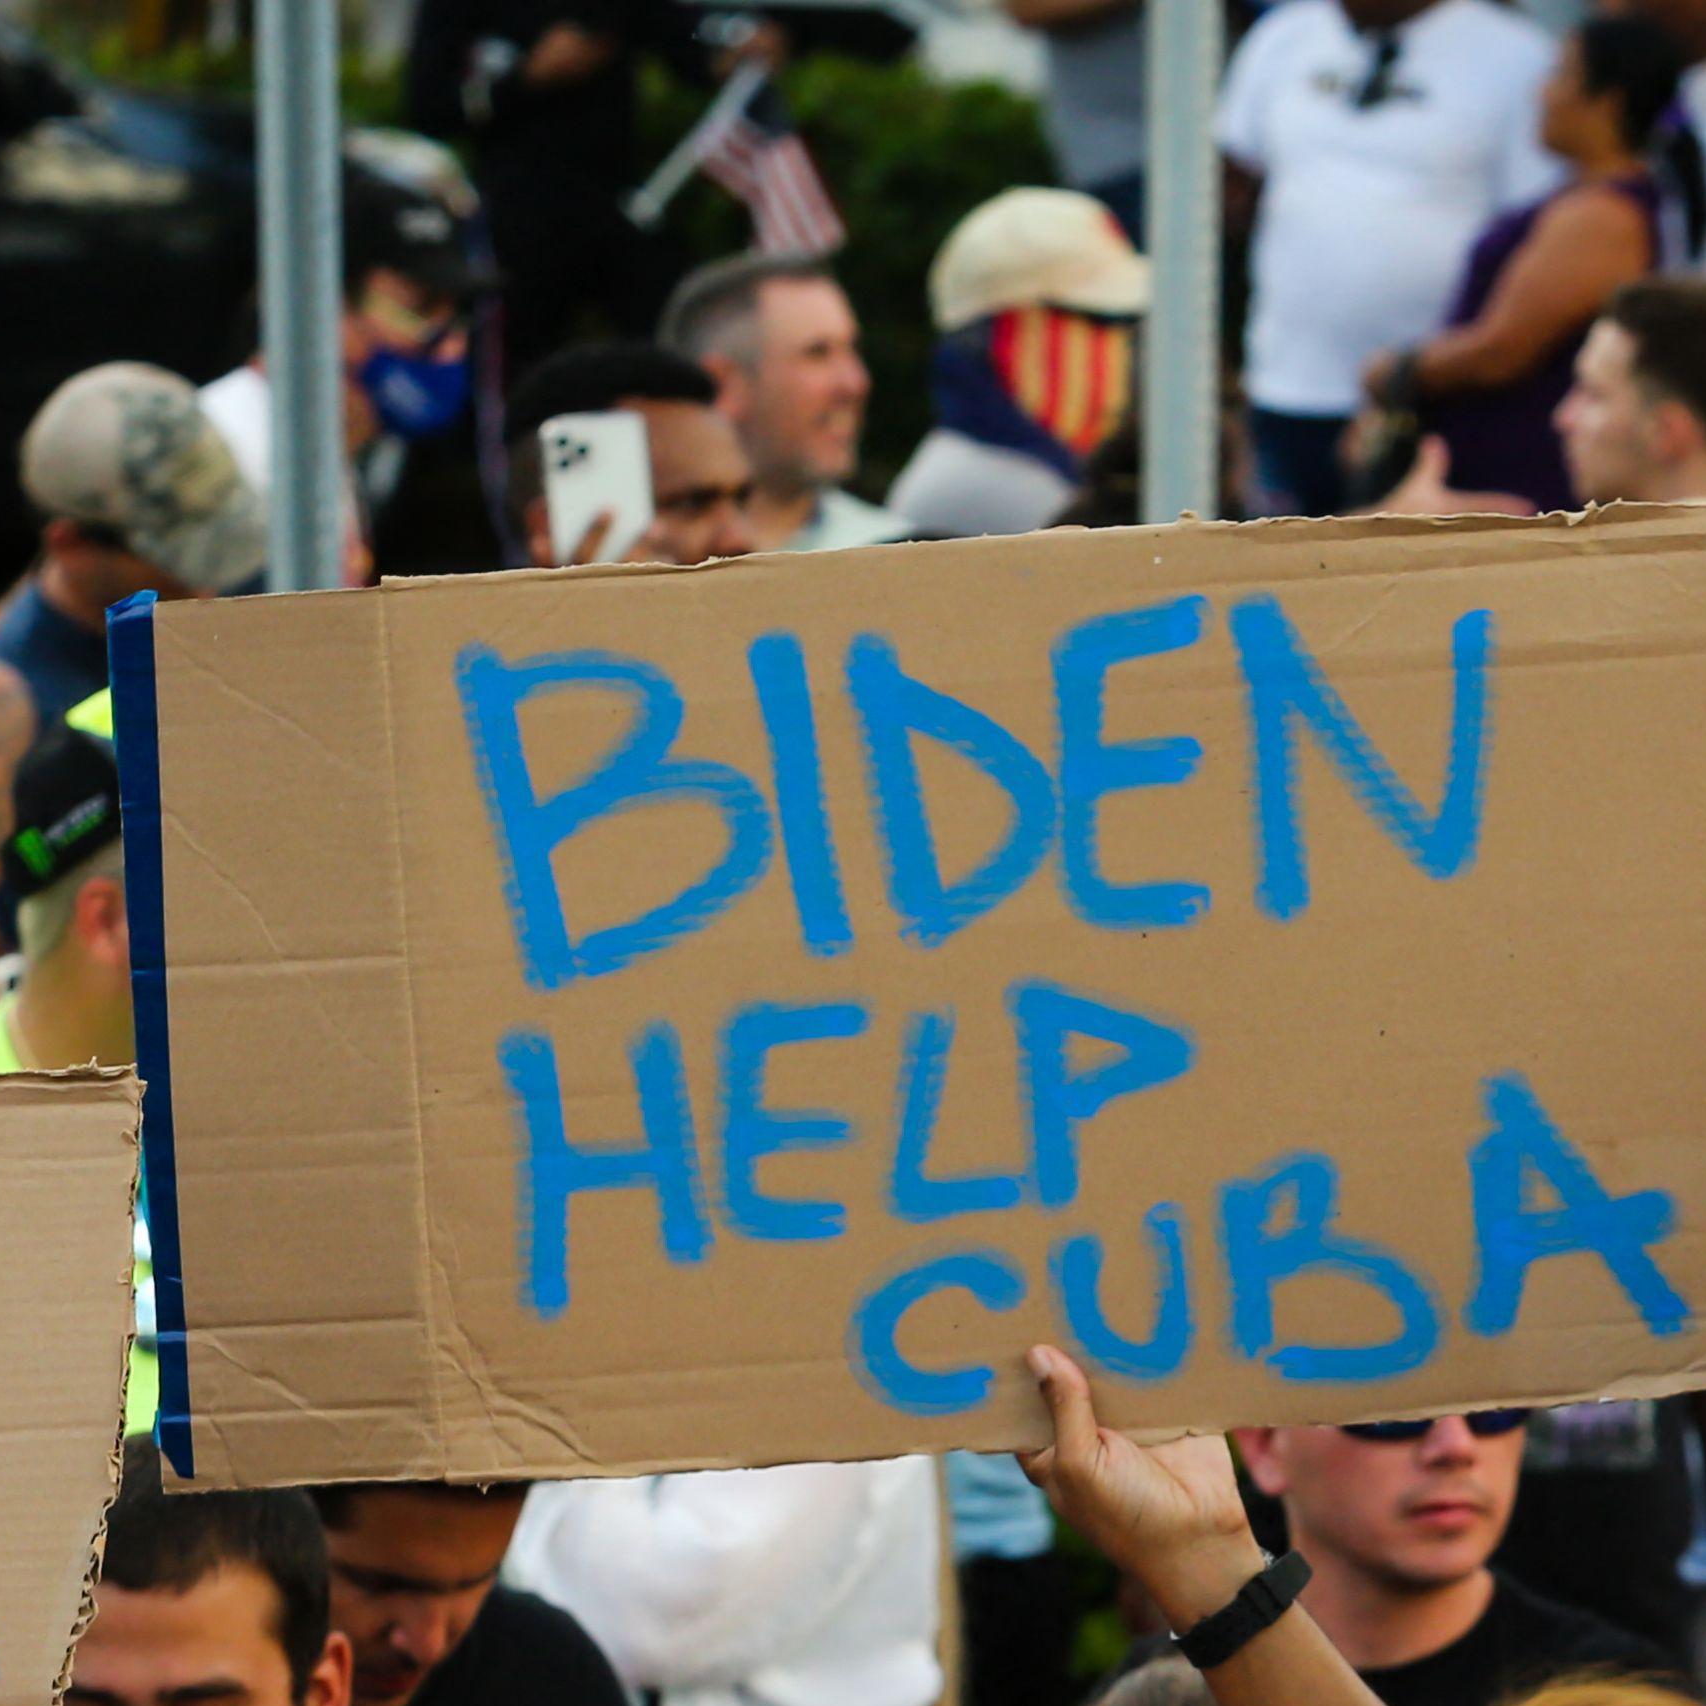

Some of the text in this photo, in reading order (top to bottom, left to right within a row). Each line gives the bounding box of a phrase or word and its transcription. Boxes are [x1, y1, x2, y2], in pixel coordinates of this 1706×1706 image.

[455, 594, 1495, 992] BIDEN
[497, 976, 1197, 1321] HELP
[847, 1069, 1690, 1416] CUBA
